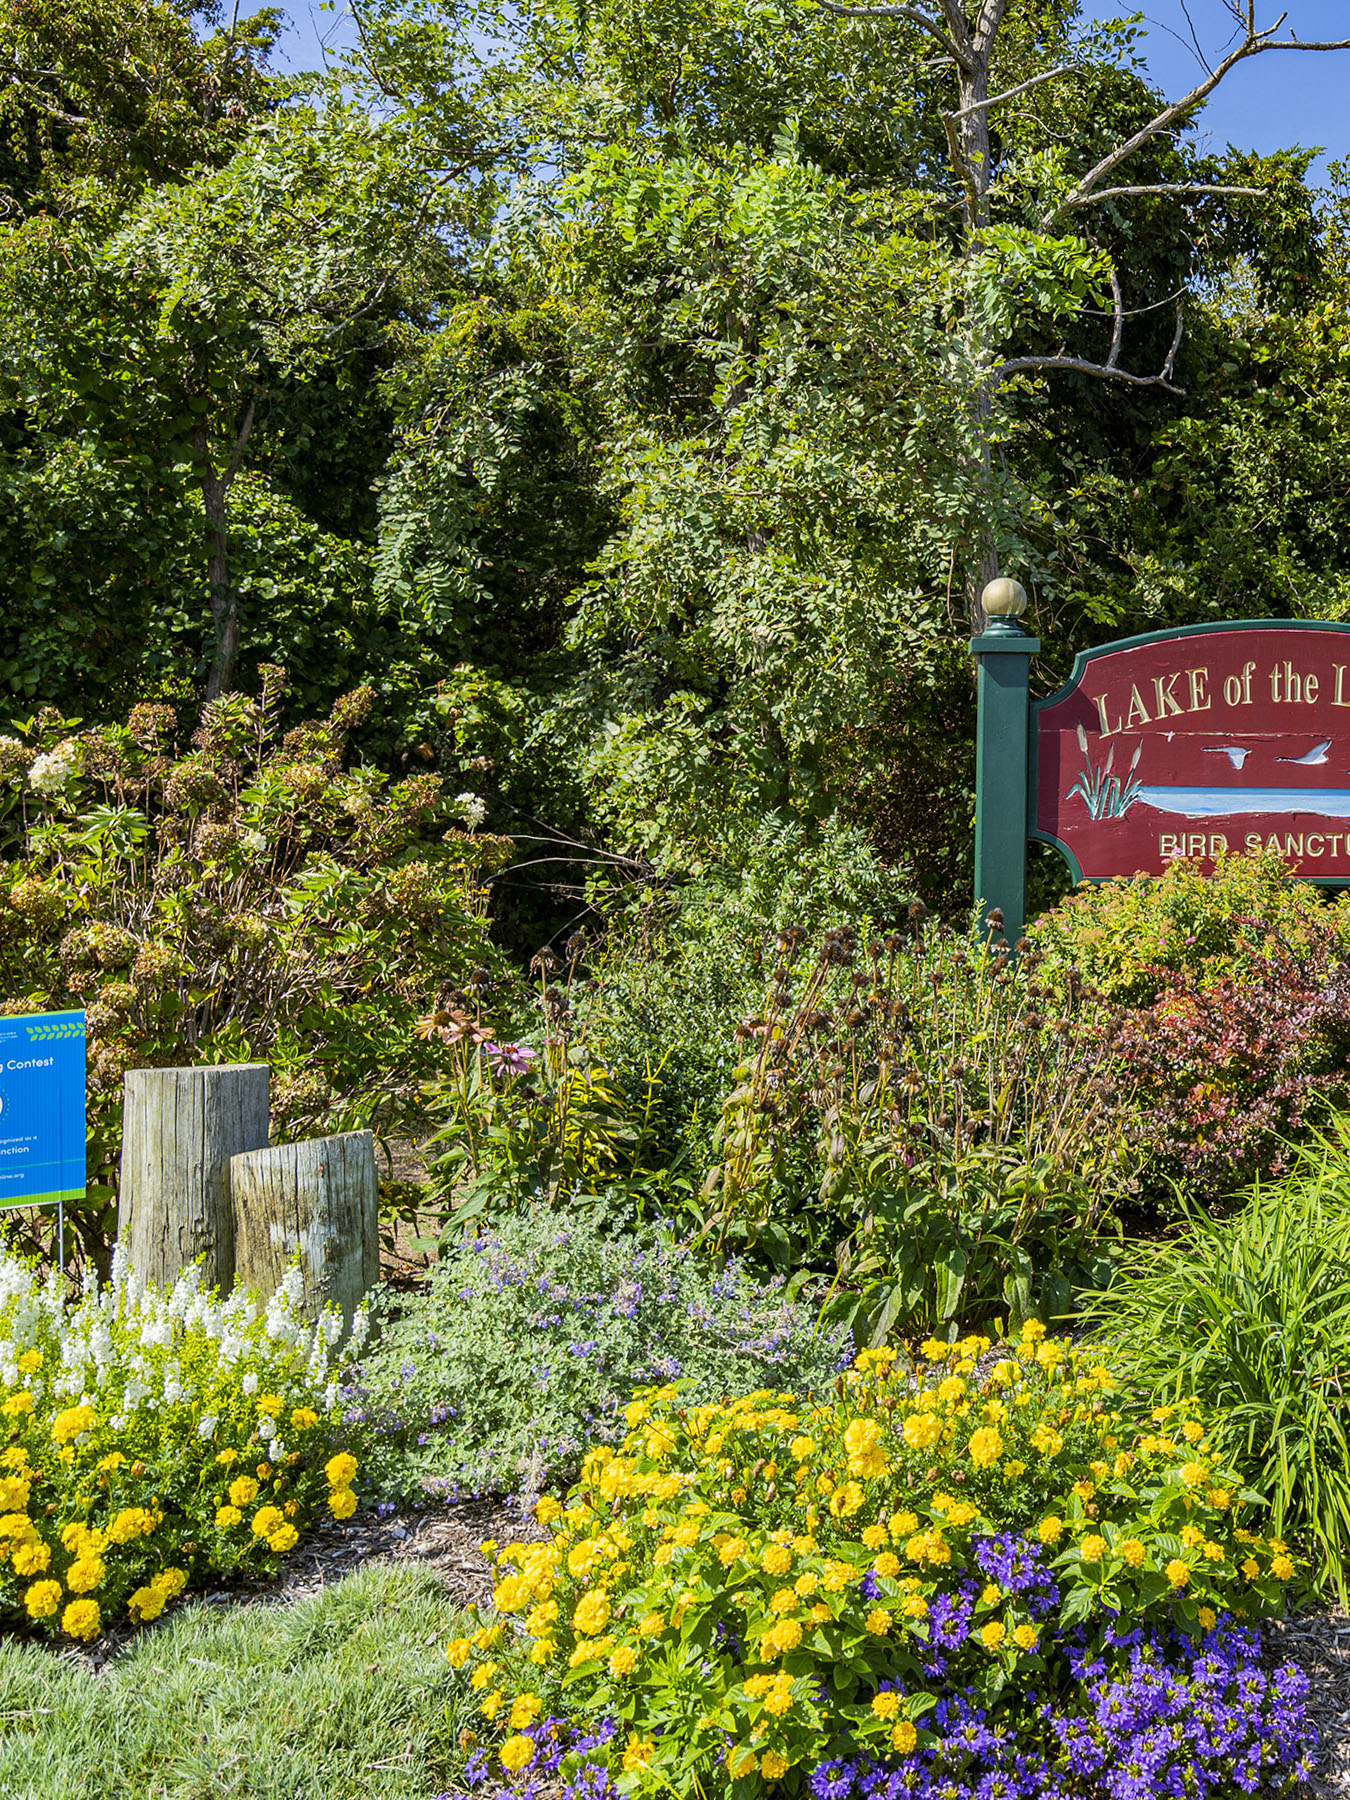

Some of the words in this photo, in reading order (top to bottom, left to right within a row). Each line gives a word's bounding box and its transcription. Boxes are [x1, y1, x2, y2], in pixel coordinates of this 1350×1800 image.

[1092, 666, 1212, 740] LAKE
[1223, 661, 1256, 707] of
[1268, 660, 1320, 704] the
[1158, 832, 1229, 857] BIRD
[7, 1056, 54, 1070] Contest
